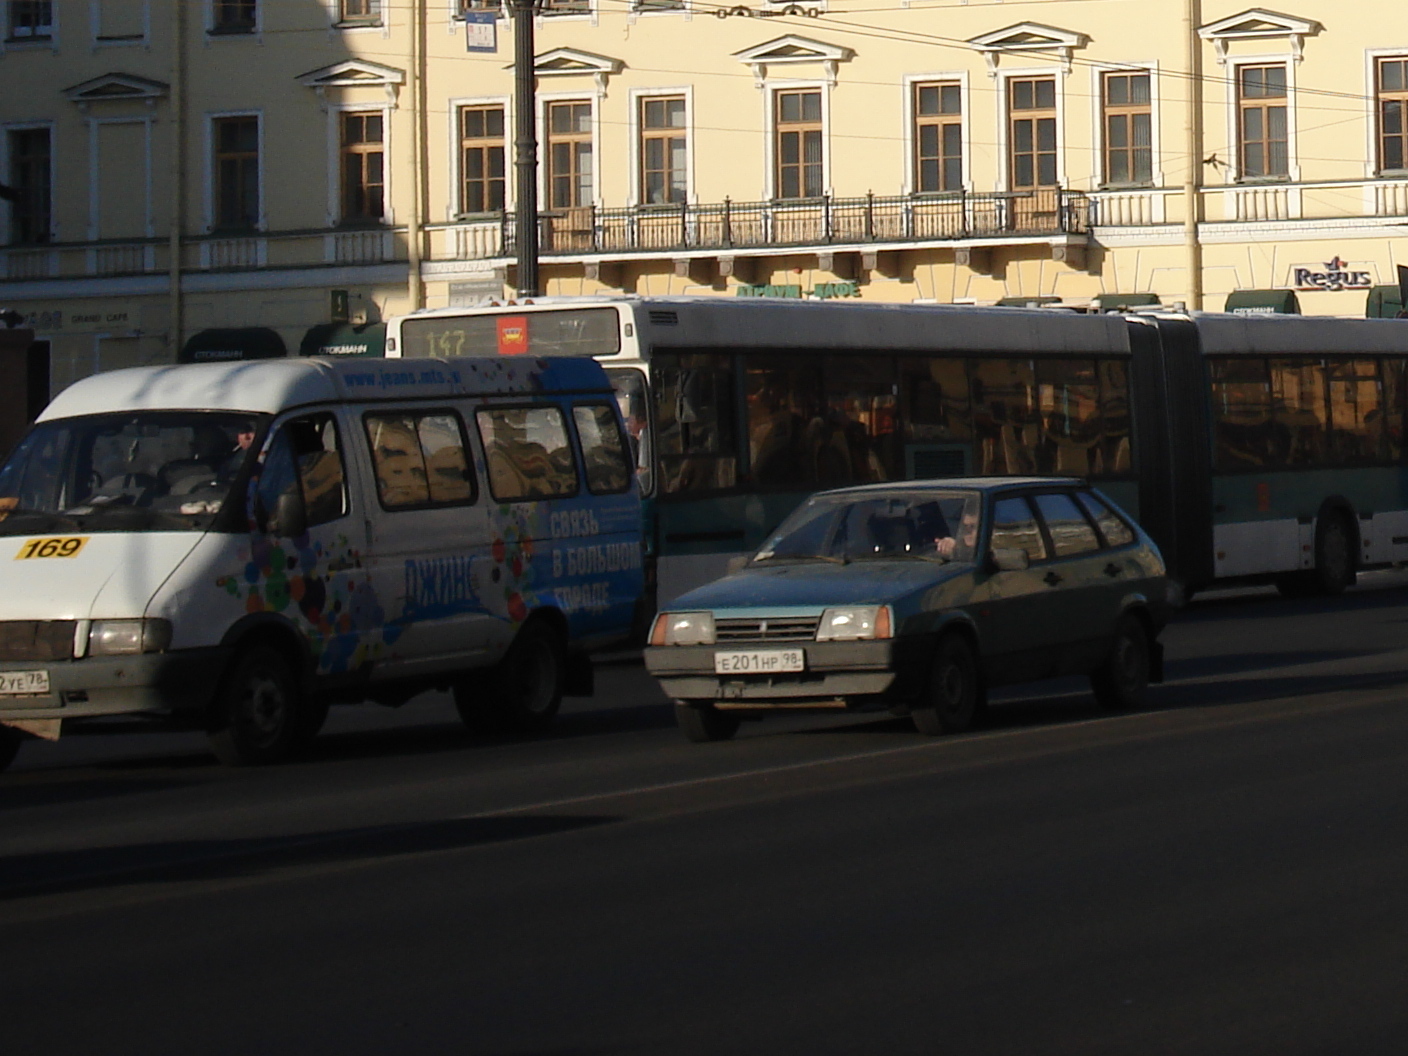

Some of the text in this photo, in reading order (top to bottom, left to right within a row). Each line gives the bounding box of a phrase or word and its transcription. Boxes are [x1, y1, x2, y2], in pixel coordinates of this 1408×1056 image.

[1294, 266, 1371, 291] Regus
[550, 508, 600, 538] СВЯЗЬ
[26, 538, 82, 559] 169
[552, 541, 641, 578] В БОЛЬШОМ
